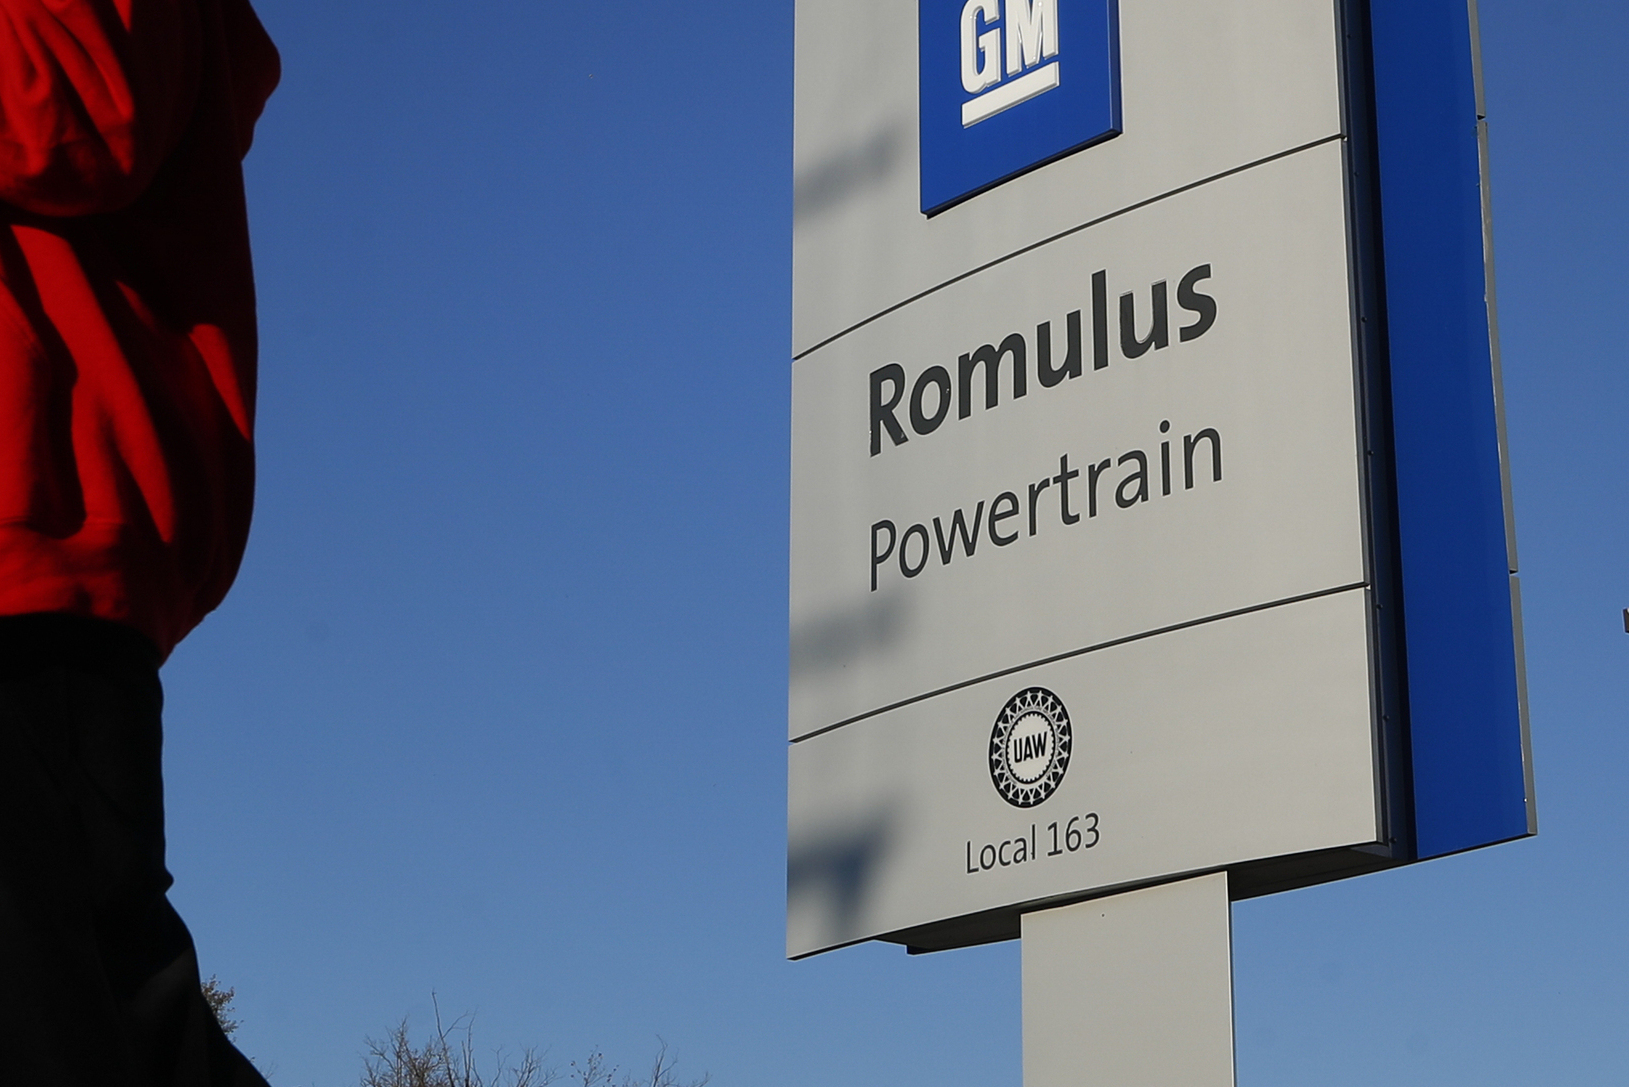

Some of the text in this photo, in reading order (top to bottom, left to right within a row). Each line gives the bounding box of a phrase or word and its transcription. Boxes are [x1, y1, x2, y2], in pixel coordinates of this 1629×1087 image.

[868, 263, 1218, 457] Romulus
[869, 419, 1223, 592] Powertrain
[1013, 731, 1048, 764] UAW
[966, 812, 1101, 874] Local 163
